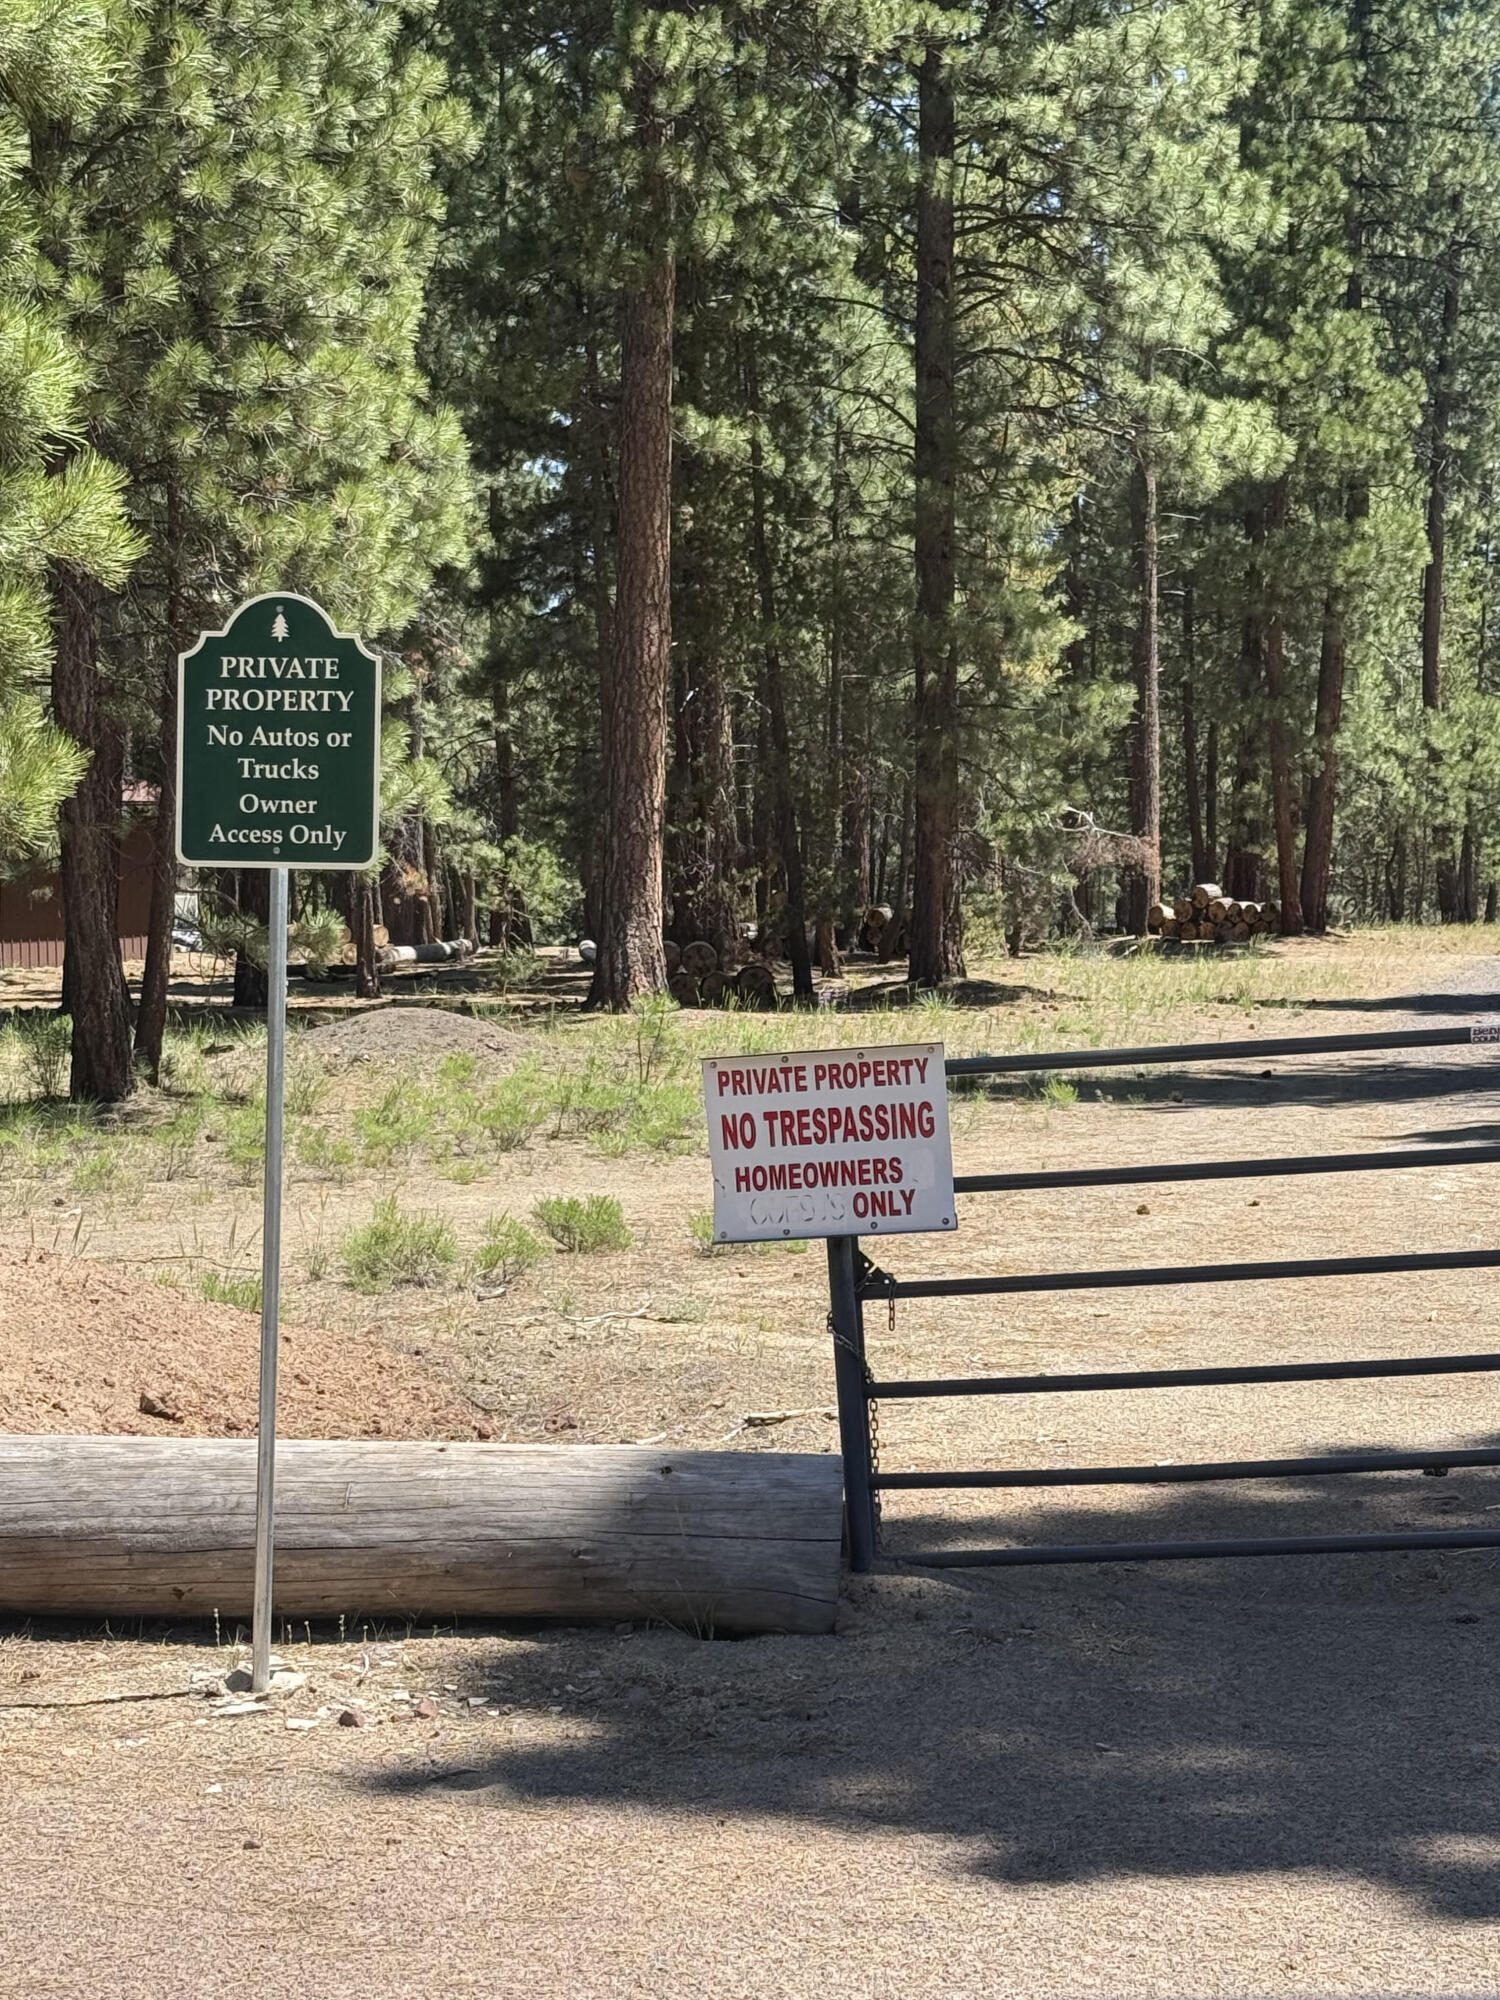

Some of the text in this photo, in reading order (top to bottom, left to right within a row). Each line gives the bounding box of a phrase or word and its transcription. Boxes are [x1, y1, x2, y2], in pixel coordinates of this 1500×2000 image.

[219, 656, 340, 680] PRIVATE
[204, 688, 354, 712] PROPERTY
[206, 724, 352, 747] No Autos or
[237, 757, 320, 780] Trucks
[239, 793, 317, 814] Owner
[208, 823, 347, 851] Access Only
[717, 1057, 929, 1097] PRIVATE PROPERTY
[721, 1101, 935, 1150] NO TRESPASSING
[734, 1157, 904, 1192] HOMEOWNERS
[852, 1188, 916, 1219] ONLY
